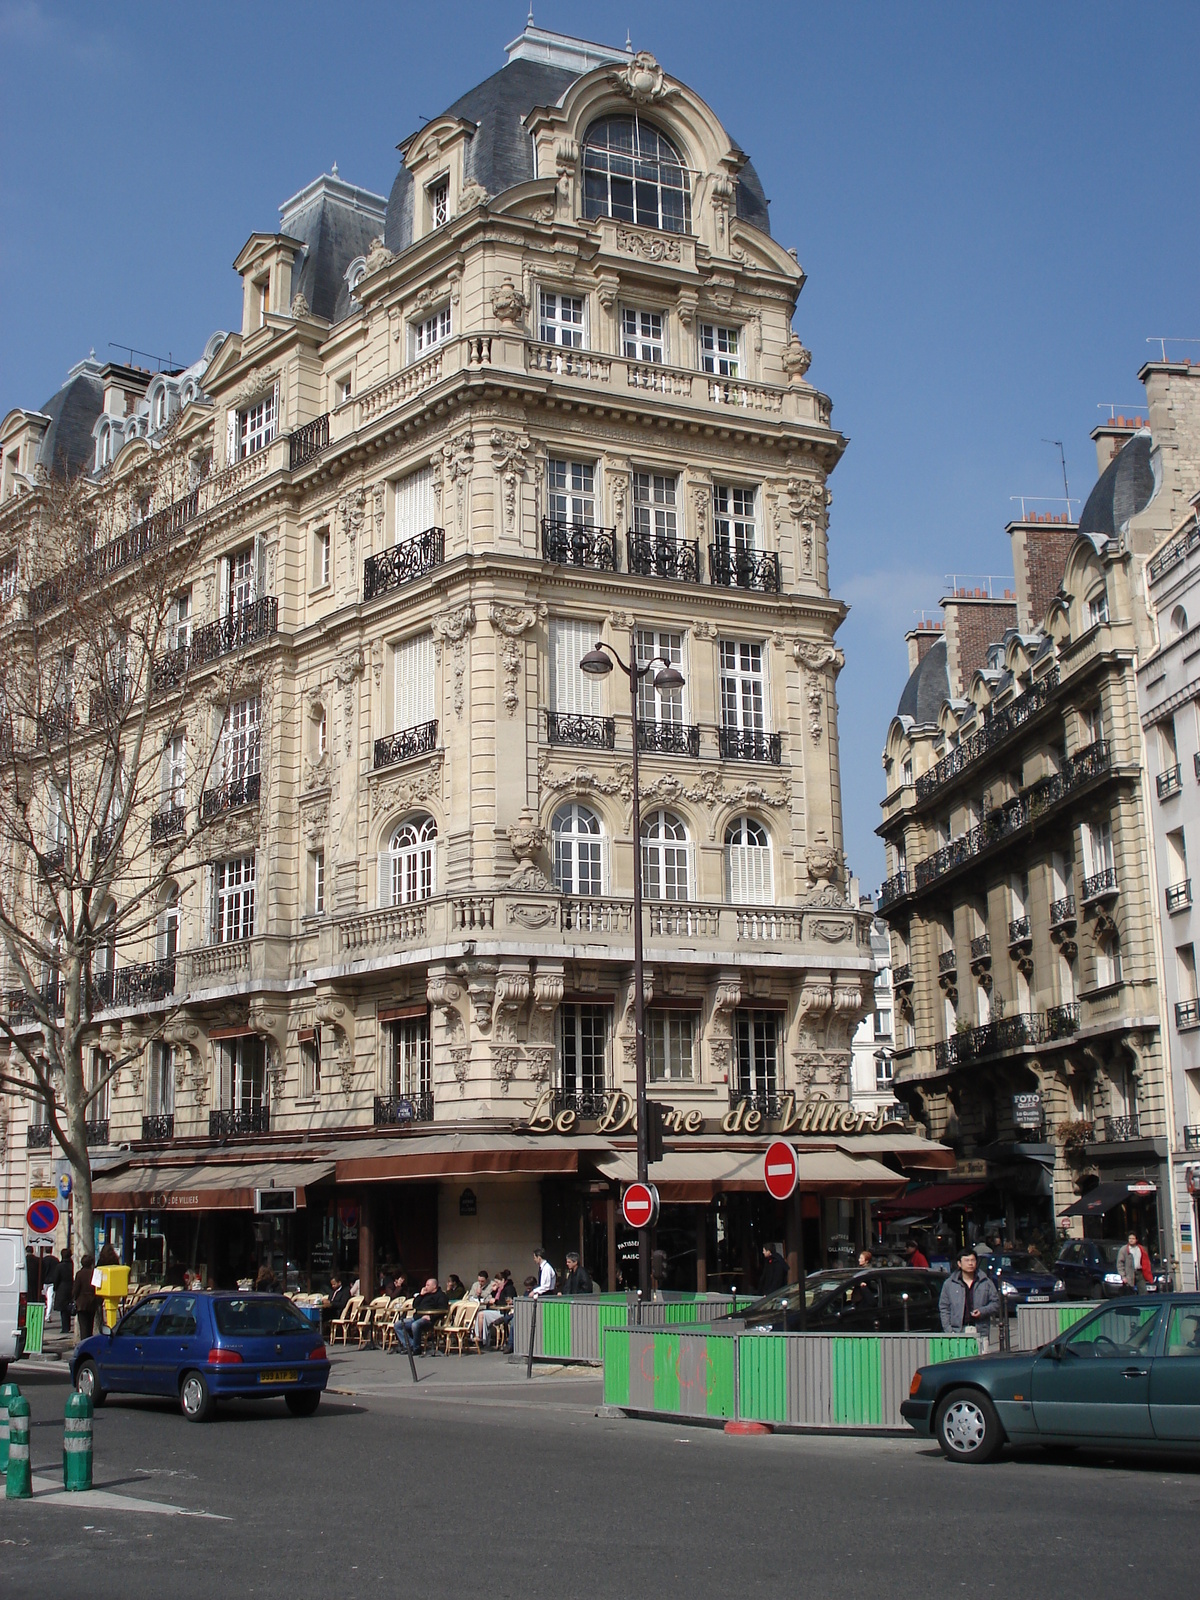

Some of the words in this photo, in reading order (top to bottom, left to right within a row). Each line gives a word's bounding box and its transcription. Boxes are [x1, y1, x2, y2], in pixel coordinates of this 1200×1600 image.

[1014, 1095, 1040, 1103] FOTO
[513, 1090, 576, 1132] Le
[721, 1099, 762, 1132] de
[779, 1091, 906, 1133] Villiers
[171, 1196, 178, 1204] DE
